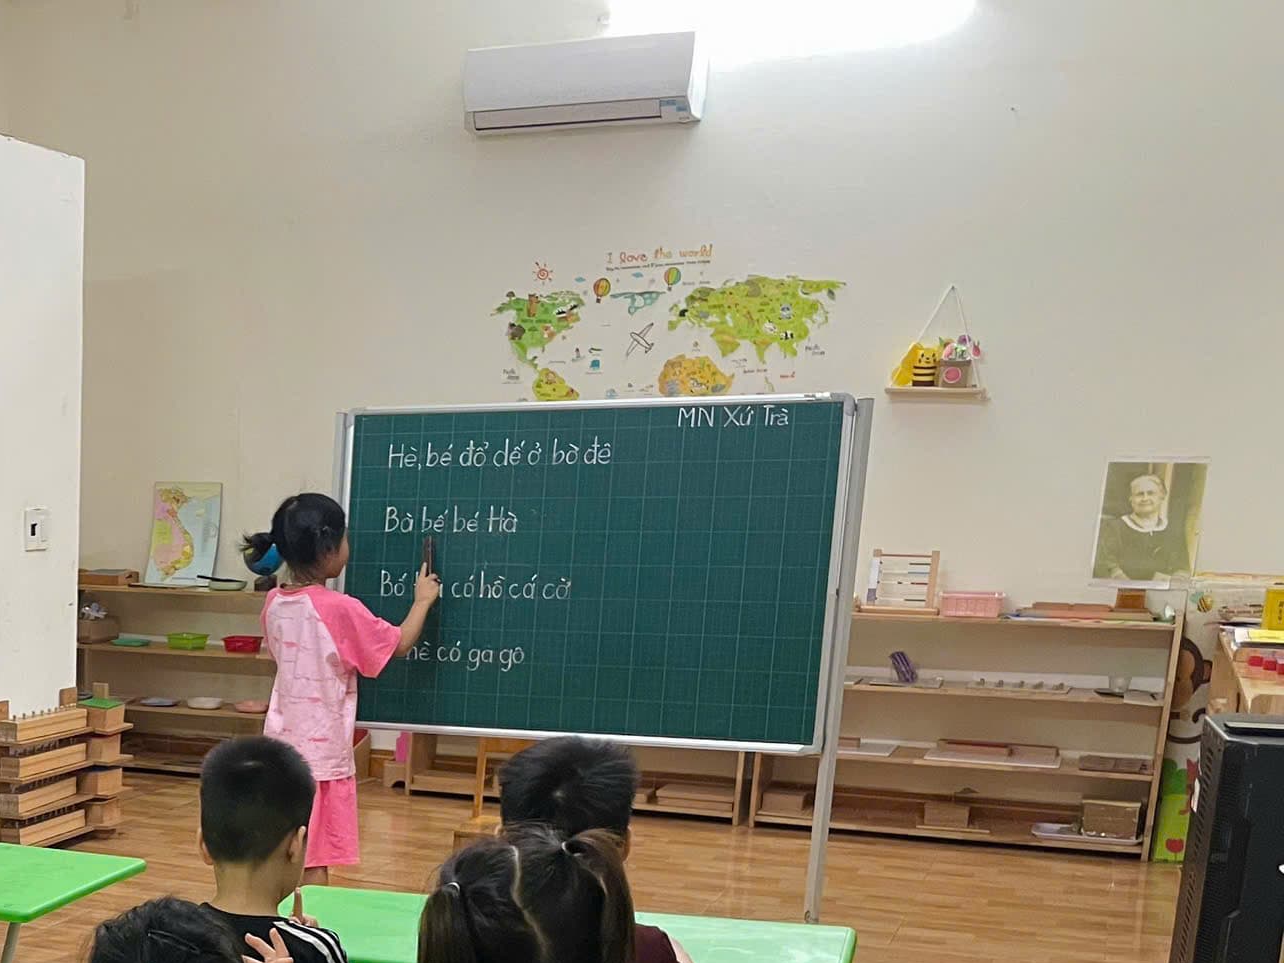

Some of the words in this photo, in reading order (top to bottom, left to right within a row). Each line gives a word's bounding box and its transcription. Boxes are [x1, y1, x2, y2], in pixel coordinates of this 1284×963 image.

[678, 405, 715, 428] MN
[723, 405, 754, 428] Xứ
[763, 404, 789, 427] Trà
[426, 442, 454, 467] bé
[492, 438, 526, 467] dế
[527, 441, 542, 466] ở
[552, 438, 580, 465] bờ
[583, 436, 612, 465] đê
[384, 506, 414, 533] Bà
[421, 506, 448, 533] bế
[453, 505, 479, 533] bé
[487, 505, 518, 533] Hà
[380, 569, 408, 597] Bố
[451, 574, 475, 599] có
[479, 569, 506, 599] hồ
[508, 573, 538, 599] cá
[542, 576, 571, 600] cờ
[437, 640, 461, 662] có
